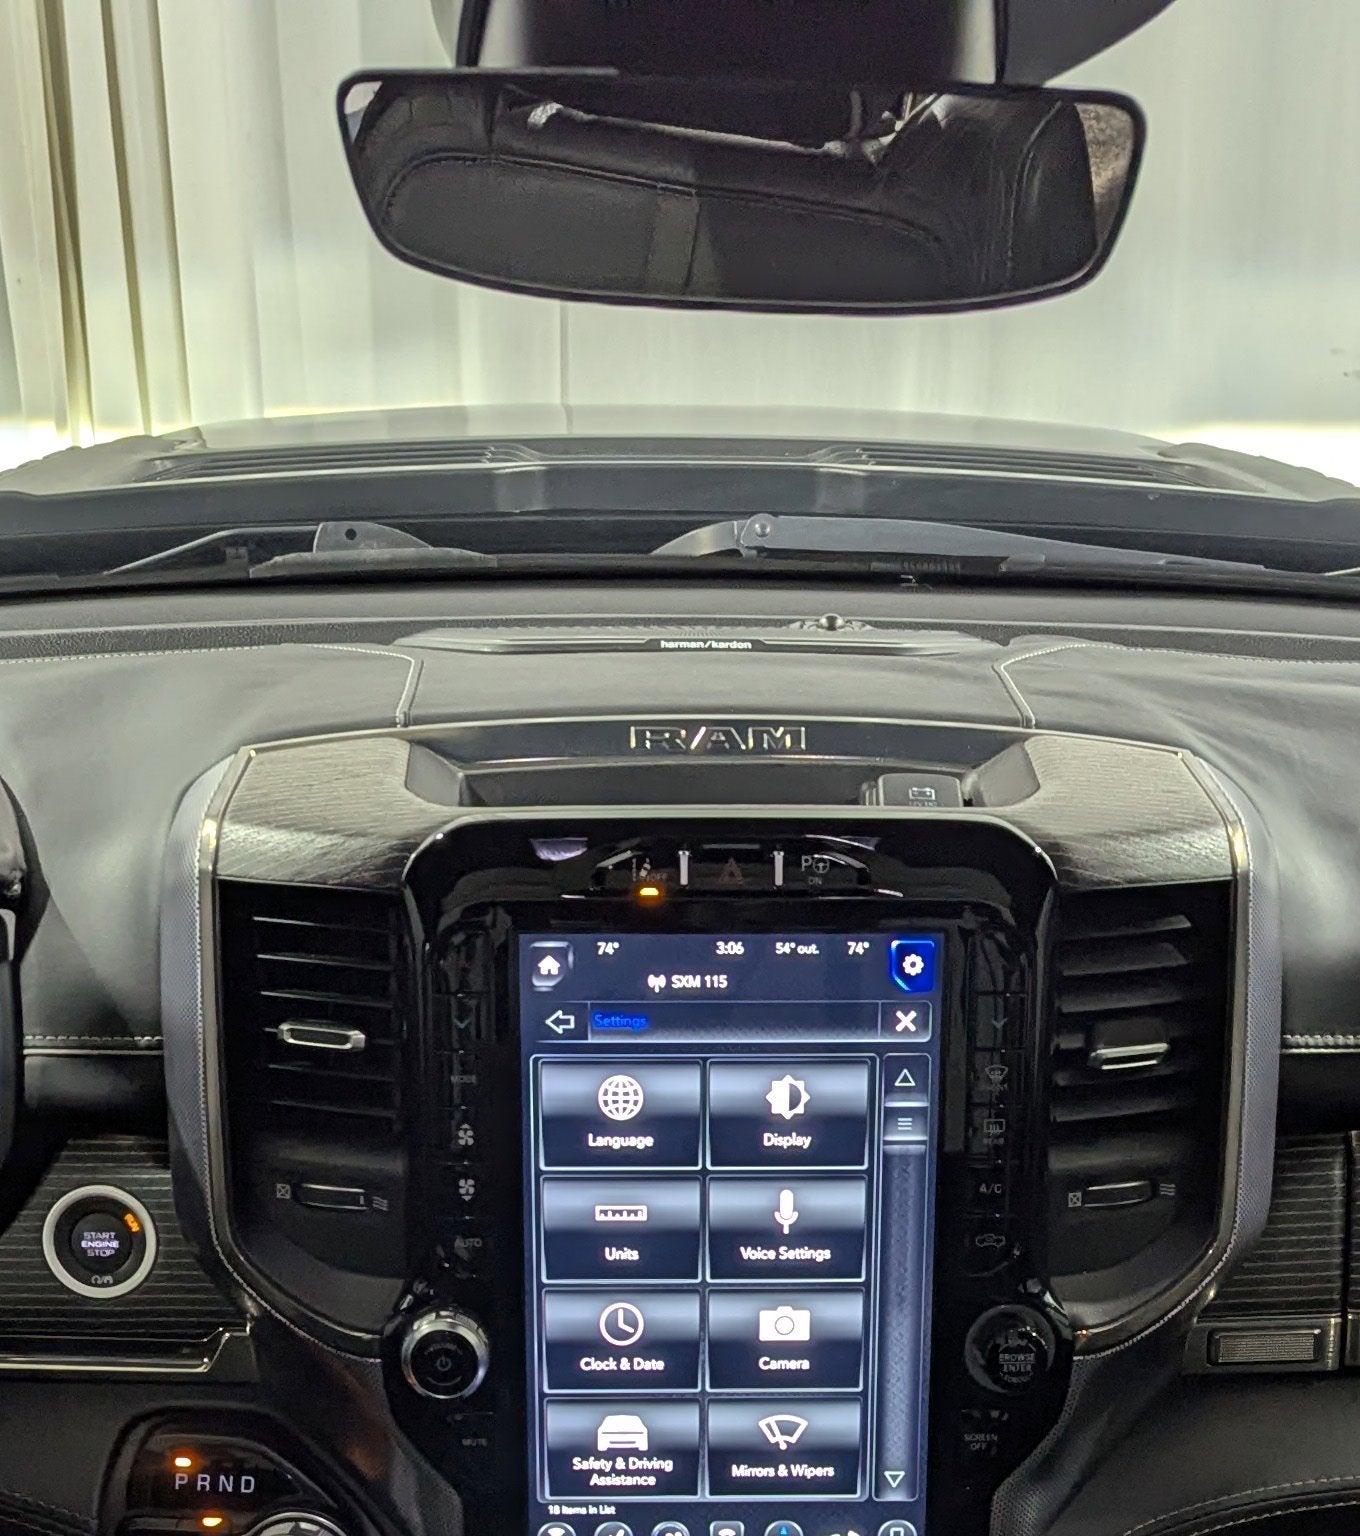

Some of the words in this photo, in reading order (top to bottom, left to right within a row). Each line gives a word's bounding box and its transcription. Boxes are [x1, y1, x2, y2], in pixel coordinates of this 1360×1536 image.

[660, 640, 752, 649] harman/kardon
[630, 726, 806, 750] RAM
[597, 942, 619, 955] 74°
[715, 942, 744, 956] 3:06
[775, 942, 796, 955] 54°
[797, 943, 819, 955] out.
[847, 941, 870, 955] 74°
[671, 974, 700, 989] SXM
[704, 974, 728, 989] 115
[593, 1013, 648, 1030] Settings
[588, 1132, 654, 1149] Language
[763, 1133, 812, 1149] Display
[979, 1184, 1002, 1194] A/C
[83, 1232, 116, 1240] START
[81, 1240, 119, 1248] ENGINE
[87, 1249, 115, 1257] STOP
[605, 1246, 640, 1261] Units
[740, 1247, 776, 1260] Voice
[779, 1246, 831, 1262] Settings
[579, 1357, 618, 1371] Clock
[620, 1357, 631, 1371] &
[633, 1357, 665, 1371] Date
[758, 1357, 810, 1371] Camera
[572, 1457, 613, 1472] Safety
[615, 1458, 626, 1471] &
[628, 1457, 674, 1472] Driving
[731, 1464, 775, 1478] Mirrors
[778, 1465, 789, 1478] &
[790, 1464, 835, 1480] Wipers
[175, 1474, 188, 1489] P
[197, 1474, 210, 1490] R
[219, 1476, 233, 1491] N
[240, 1476, 255, 1493] D
[589, 1473, 656, 1487] Assistance
[561, 1505, 587, 1515] Items
[589, 1505, 597, 1515] in
[599, 1505, 616, 1515] List
